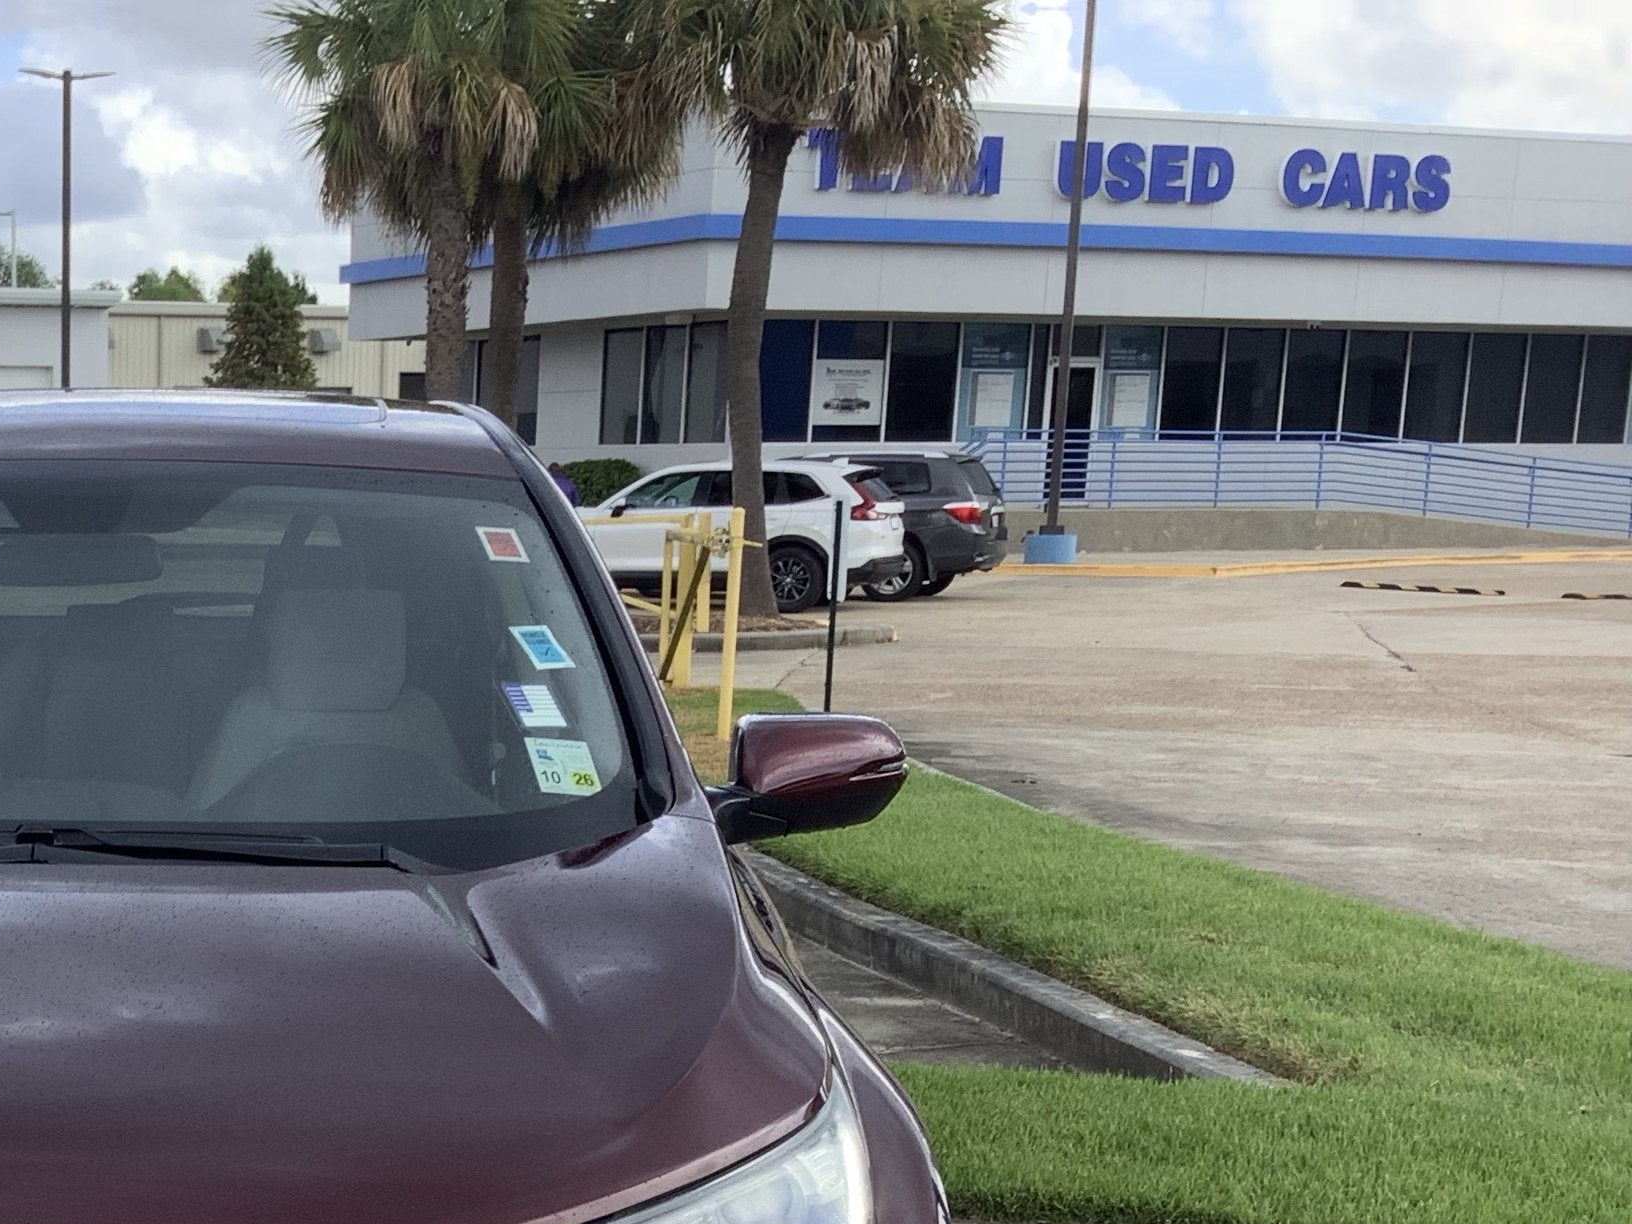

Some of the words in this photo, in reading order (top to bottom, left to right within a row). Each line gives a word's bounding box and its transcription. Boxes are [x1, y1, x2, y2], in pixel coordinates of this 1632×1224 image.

[1057, 140, 1235, 204] USED
[1281, 148, 1451, 212] CARS
[540, 769, 562, 785] 10
[572, 772, 595, 787] 26
